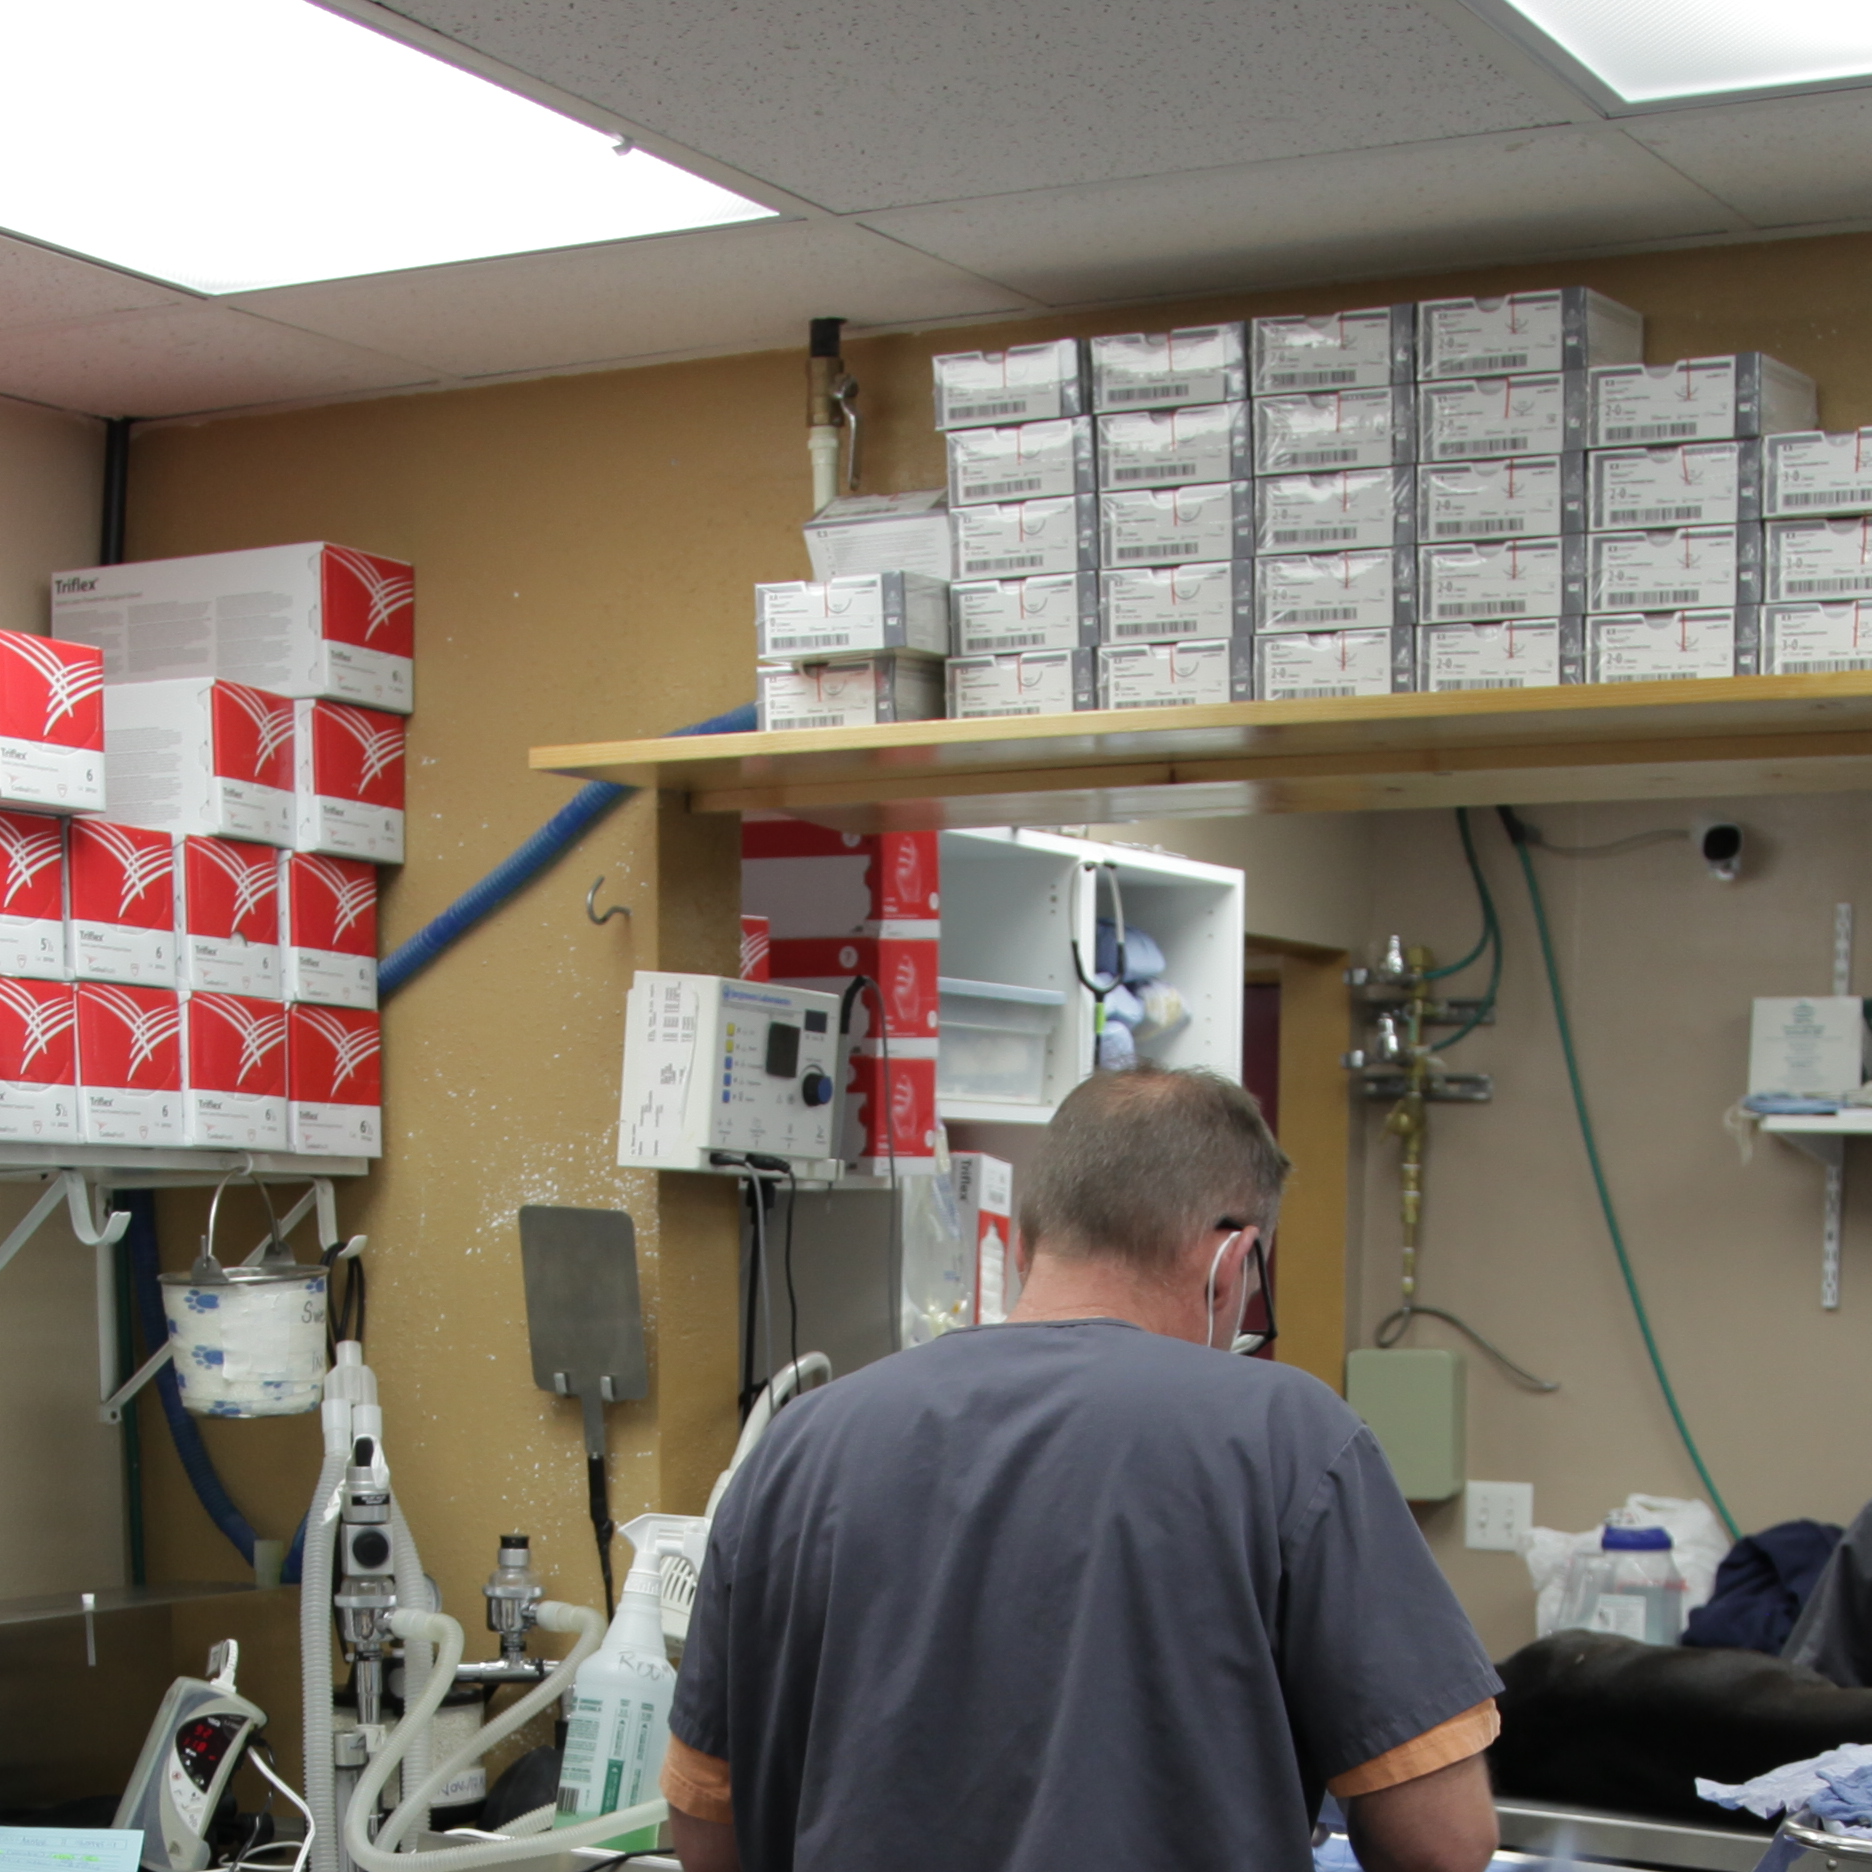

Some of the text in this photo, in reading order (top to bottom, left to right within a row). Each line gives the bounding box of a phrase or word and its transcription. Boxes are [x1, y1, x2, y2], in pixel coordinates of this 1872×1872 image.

[1438, 338, 1455, 350] 2-0
[1605, 404, 1622, 417] 2-0
[1783, 469, 1800, 483] 3-0
[1610, 487, 1626, 500] 2-0
[1435, 500, 1451, 512] 2-0
[1608, 569, 1625, 583] 2-0
[55, 577, 98, 594] Triflex
[1437, 581, 1453, 594] 2-0
[1782, 638, 1799, 651] 3-0
[1436, 658, 1452, 671] 2-0
[1606, 652, 1623, 665] 2-0
[1271, 667, 1288, 679] 2-0
[0, 746, 27, 761] Triflex
[85, 768, 94, 783] 6
[80, 929, 104, 942] Triflex
[155, 946, 163, 959] 6
[195, 944, 217, 957] Triflex
[262, 956, 269, 970] 6
[90, 1096, 115, 1107] Triflex
[198, 1098, 223, 1111] Triflex
[161, 1104, 169, 1118] 6
[960, 1158, 970, 1202] Triflex
